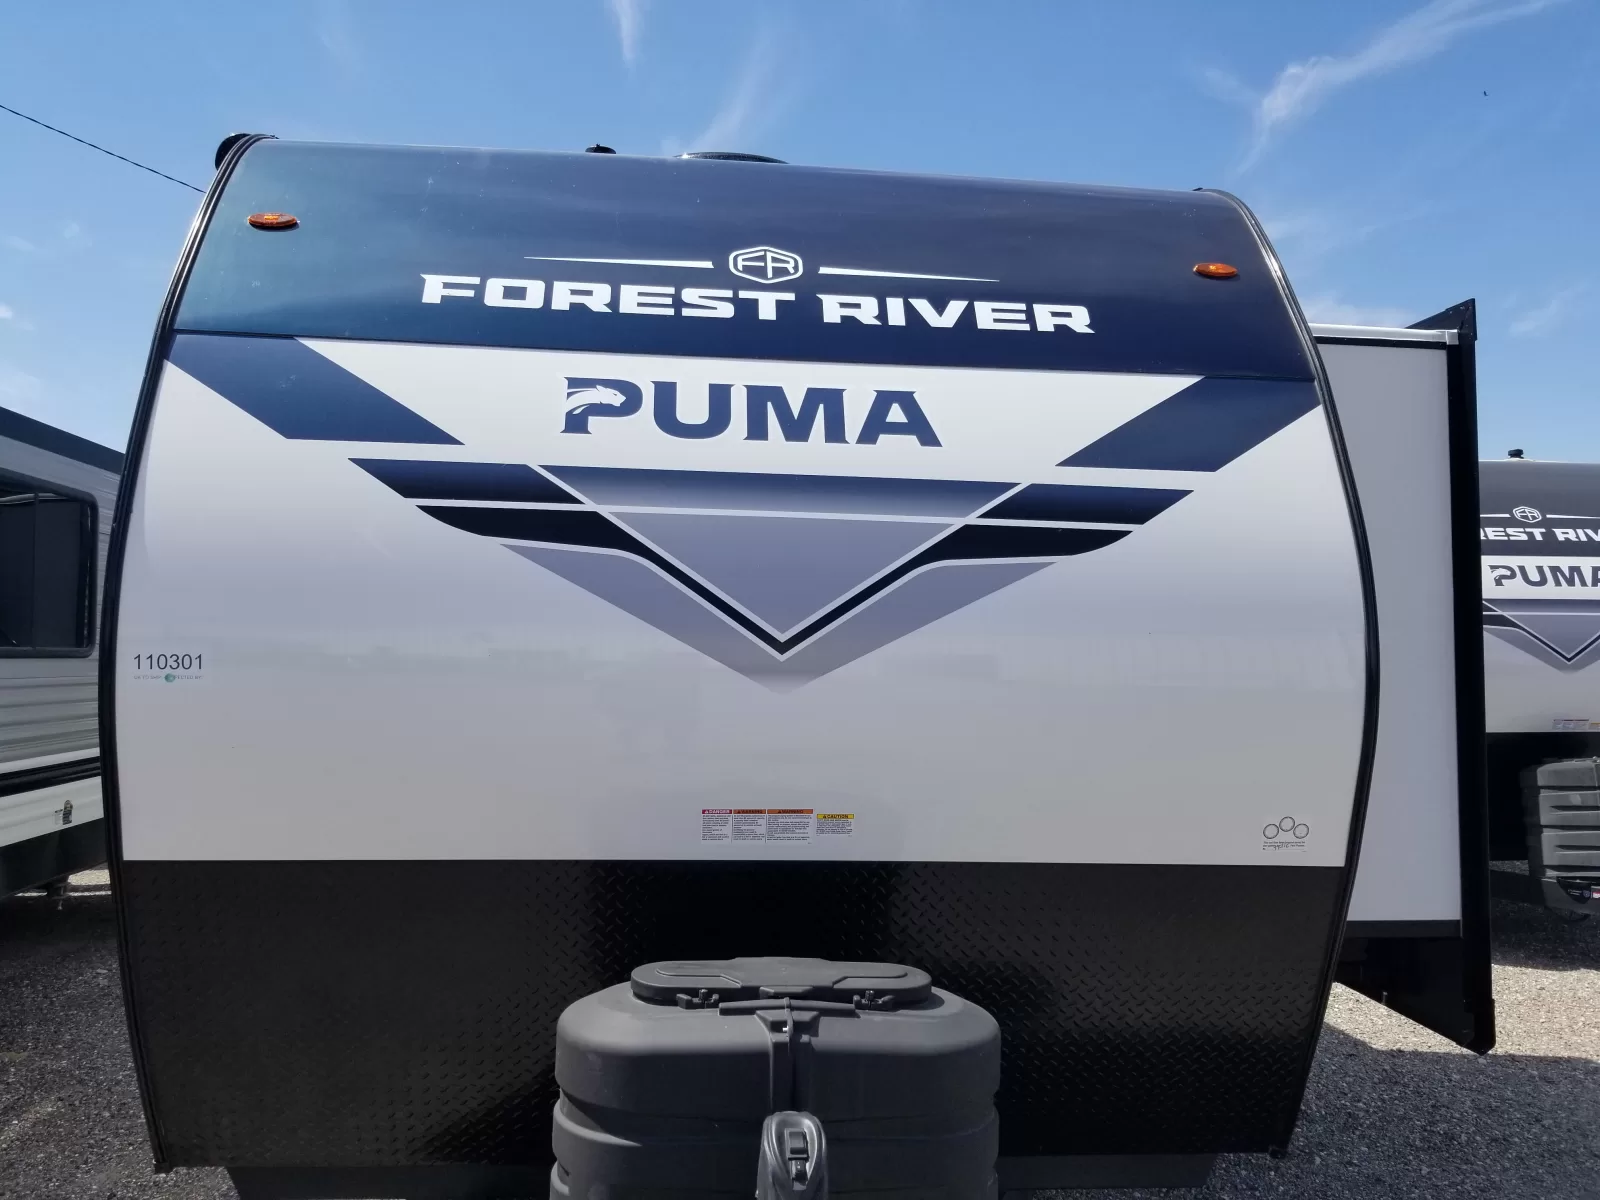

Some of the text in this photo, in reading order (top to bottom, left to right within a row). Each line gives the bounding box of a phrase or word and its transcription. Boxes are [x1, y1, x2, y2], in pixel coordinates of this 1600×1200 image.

[420, 273, 1095, 335] FOREST RIVER
[560, 376, 943, 449] PUMA
[1480, 527, 1546, 541] EST
[133, 653, 202, 670] 110301
